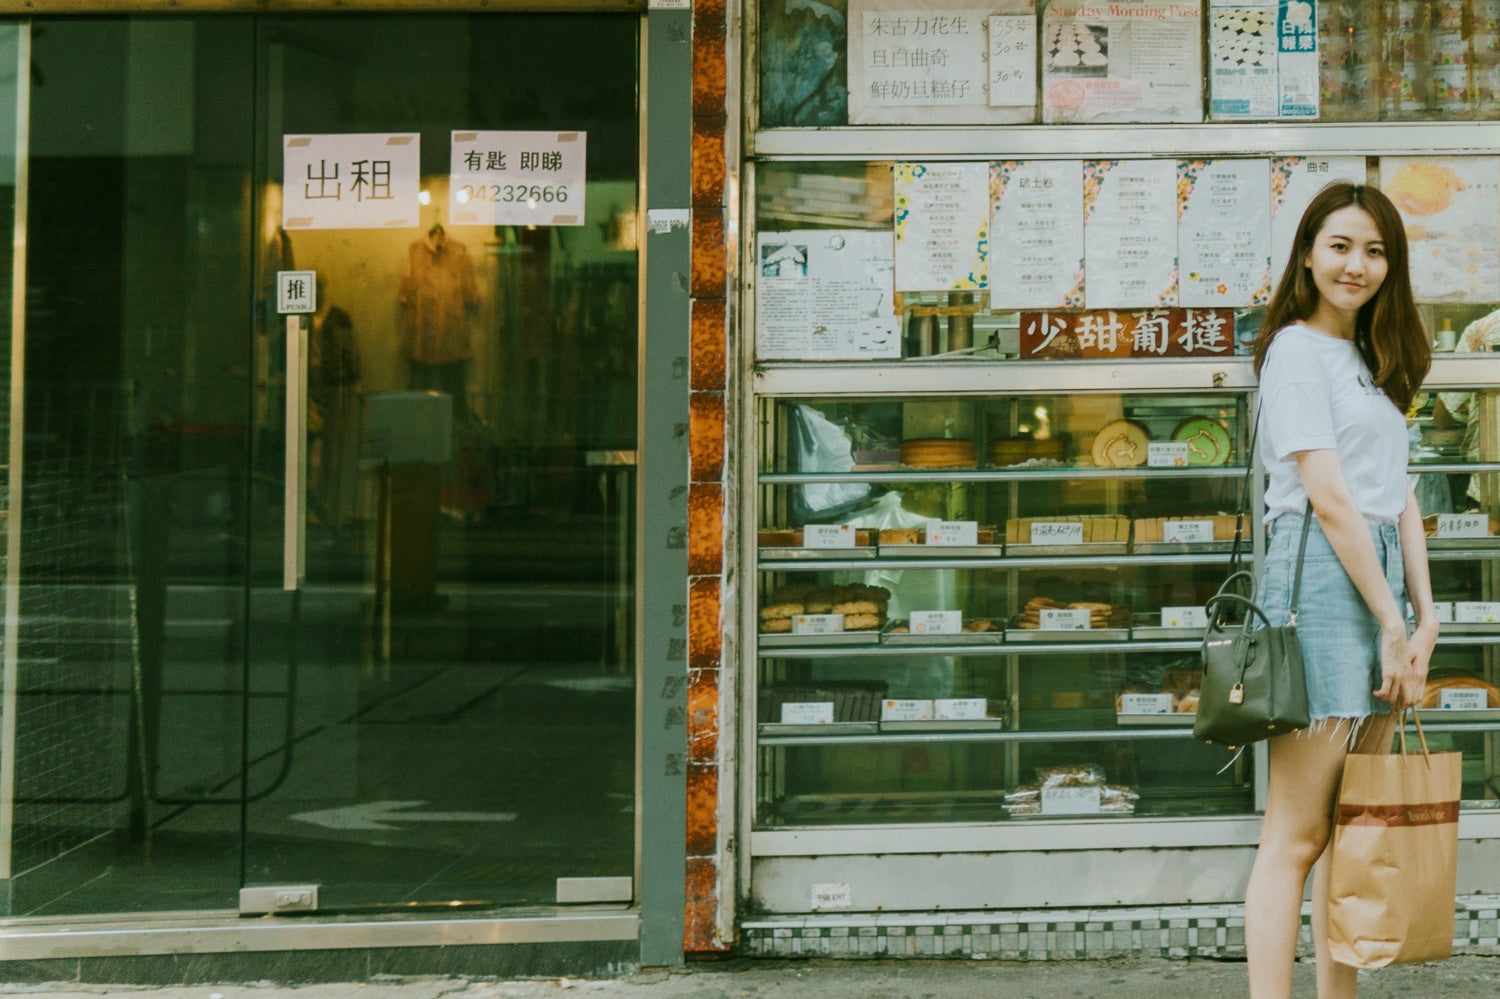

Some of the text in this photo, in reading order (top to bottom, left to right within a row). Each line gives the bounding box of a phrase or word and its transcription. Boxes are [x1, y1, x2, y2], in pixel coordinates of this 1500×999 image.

[1050, 4, 1200, 20] Sunday Morning Post
[869, 15, 970, 36] 朱古力花生
[869, 48, 950, 68] 旦白曲奇
[870, 79, 971, 99] 鮮奶旦糕仔
[463, 149, 563, 173] 有匙 即睇
[1307, 161, 1329, 173] 曲奇
[304, 158, 395, 203] 出租
[287, 279, 306, 300] 推
[1027, 309, 1229, 356] 少甜葡撻
